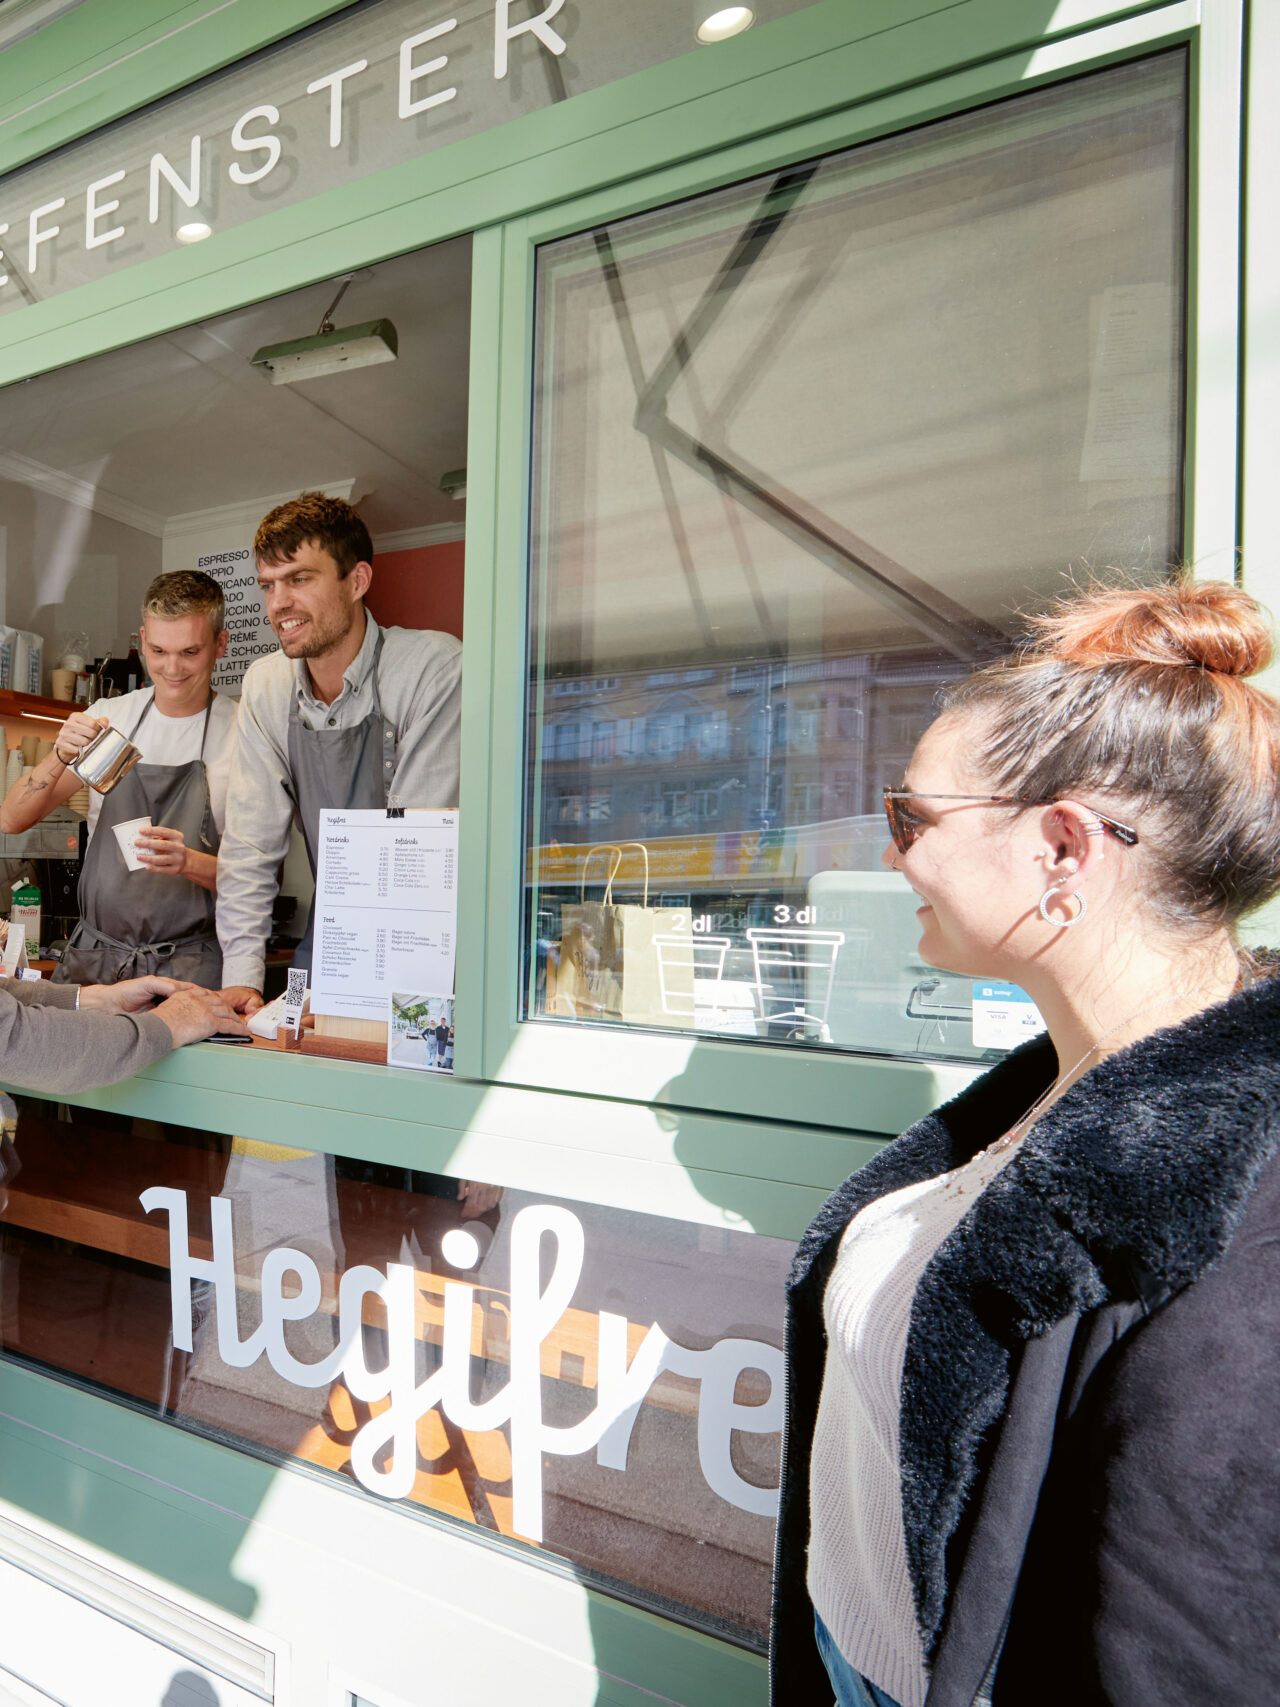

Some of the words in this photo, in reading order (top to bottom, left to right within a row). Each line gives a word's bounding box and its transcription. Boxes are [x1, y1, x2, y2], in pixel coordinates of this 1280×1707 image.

[198, 550, 250, 567] ESPRESSO
[204, 566, 234, 579] OPPIO
[220, 576, 255, 590] RICANO
[224, 603, 261, 617] UCCINO
[224, 617, 260, 630] UCCINO
[773, 904, 791, 923] 3
[796, 905, 817, 924] dl
[671, 913, 687, 932] 2
[692, 914, 712, 933] dl
[139, 1187, 785, 1542] Hegifre
